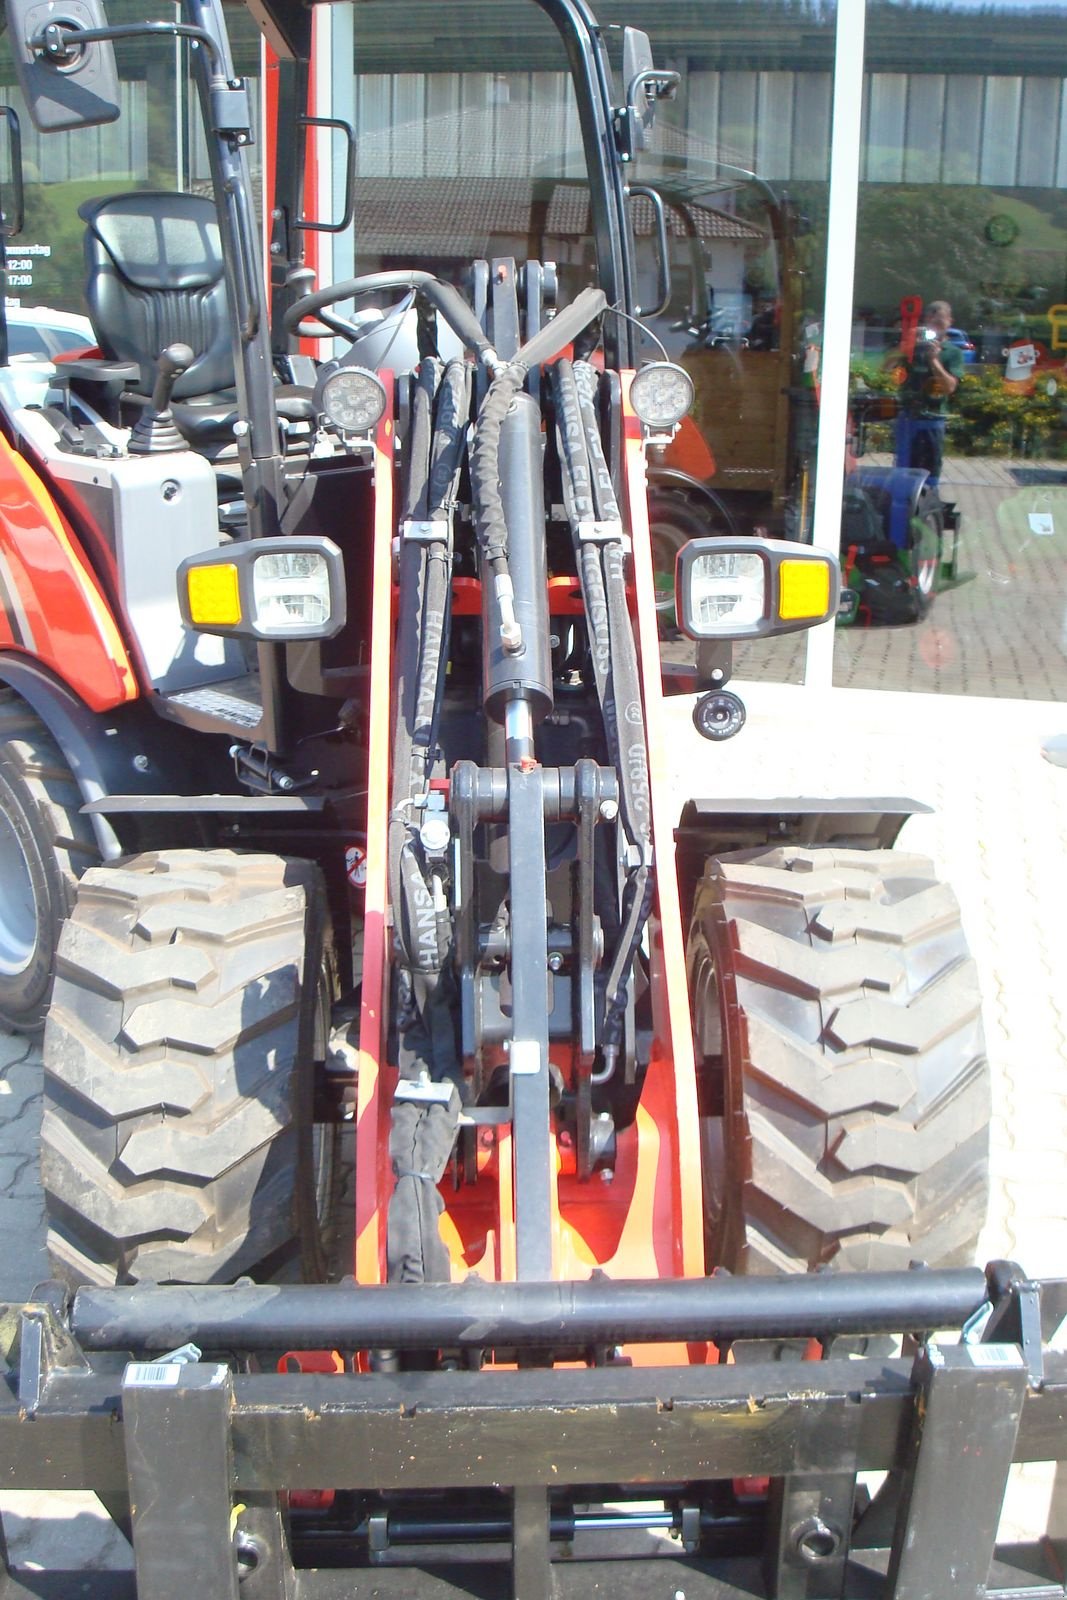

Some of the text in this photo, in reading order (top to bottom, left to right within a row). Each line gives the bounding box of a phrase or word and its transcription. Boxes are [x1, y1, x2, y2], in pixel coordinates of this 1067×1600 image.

[7, 260, 33, 270] 12:00
[7, 275, 33, 286] 17:00
[409, 871, 440, 967] HANSA
